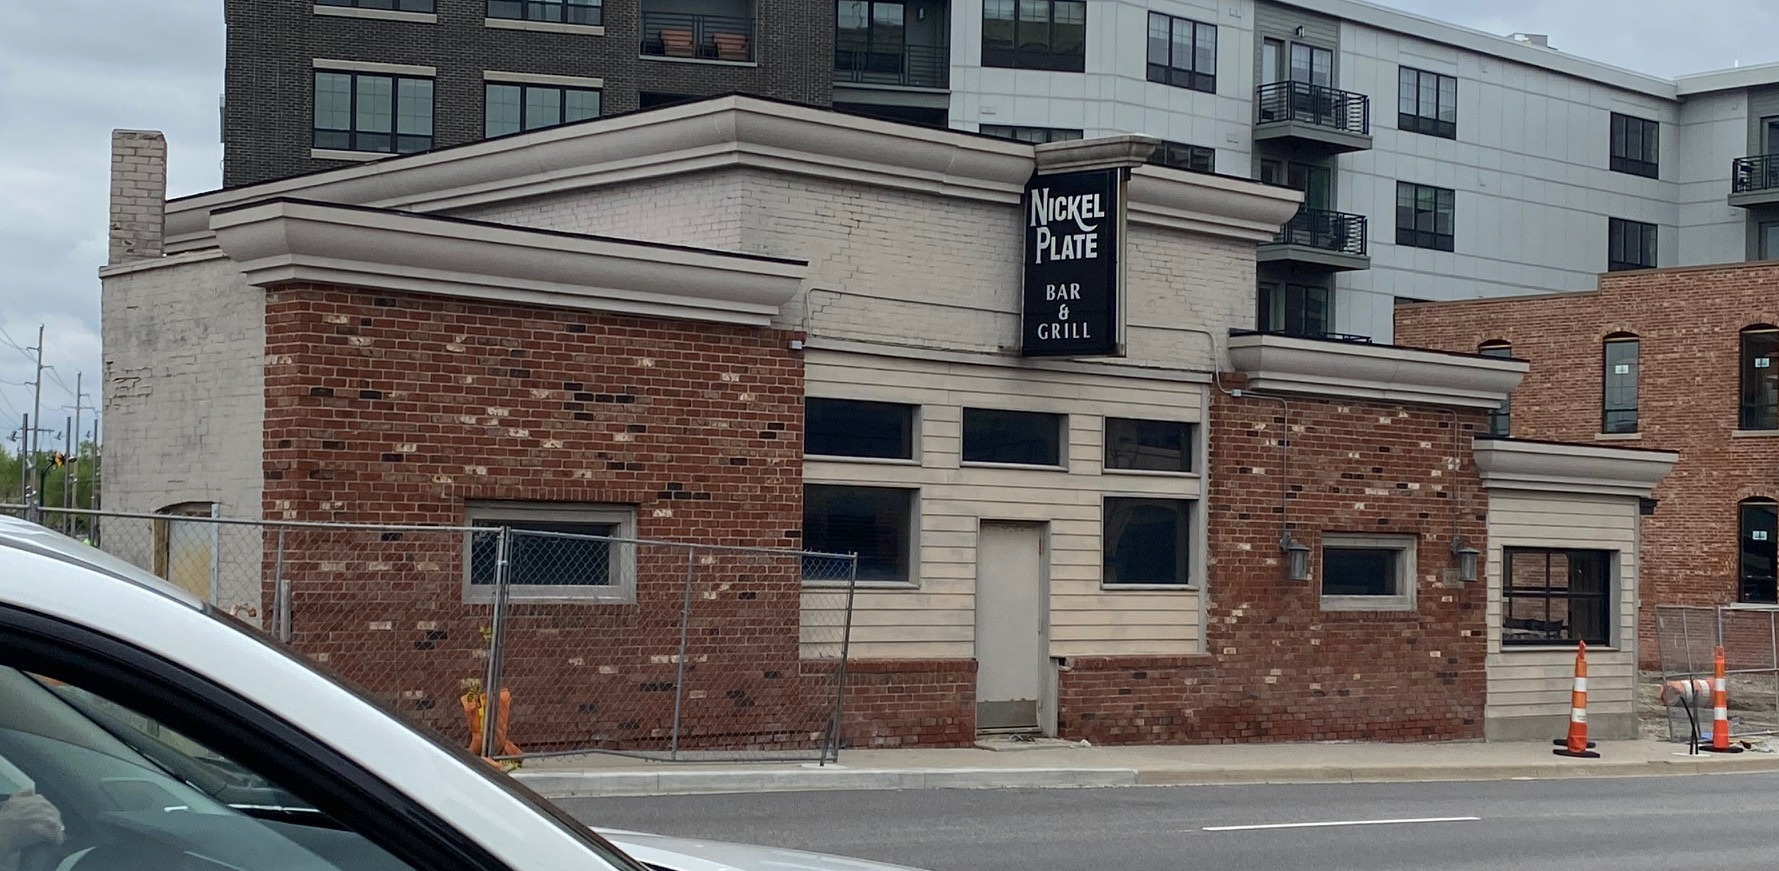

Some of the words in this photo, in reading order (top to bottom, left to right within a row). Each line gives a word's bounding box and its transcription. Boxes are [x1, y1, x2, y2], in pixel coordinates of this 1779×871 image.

[1030, 187, 1105, 231] NICKEL
[1035, 227, 1098, 264] PLATE
[1046, 283, 1081, 301] BAR
[1058, 303, 1070, 320] &
[1037, 322, 1091, 340] GRILL
